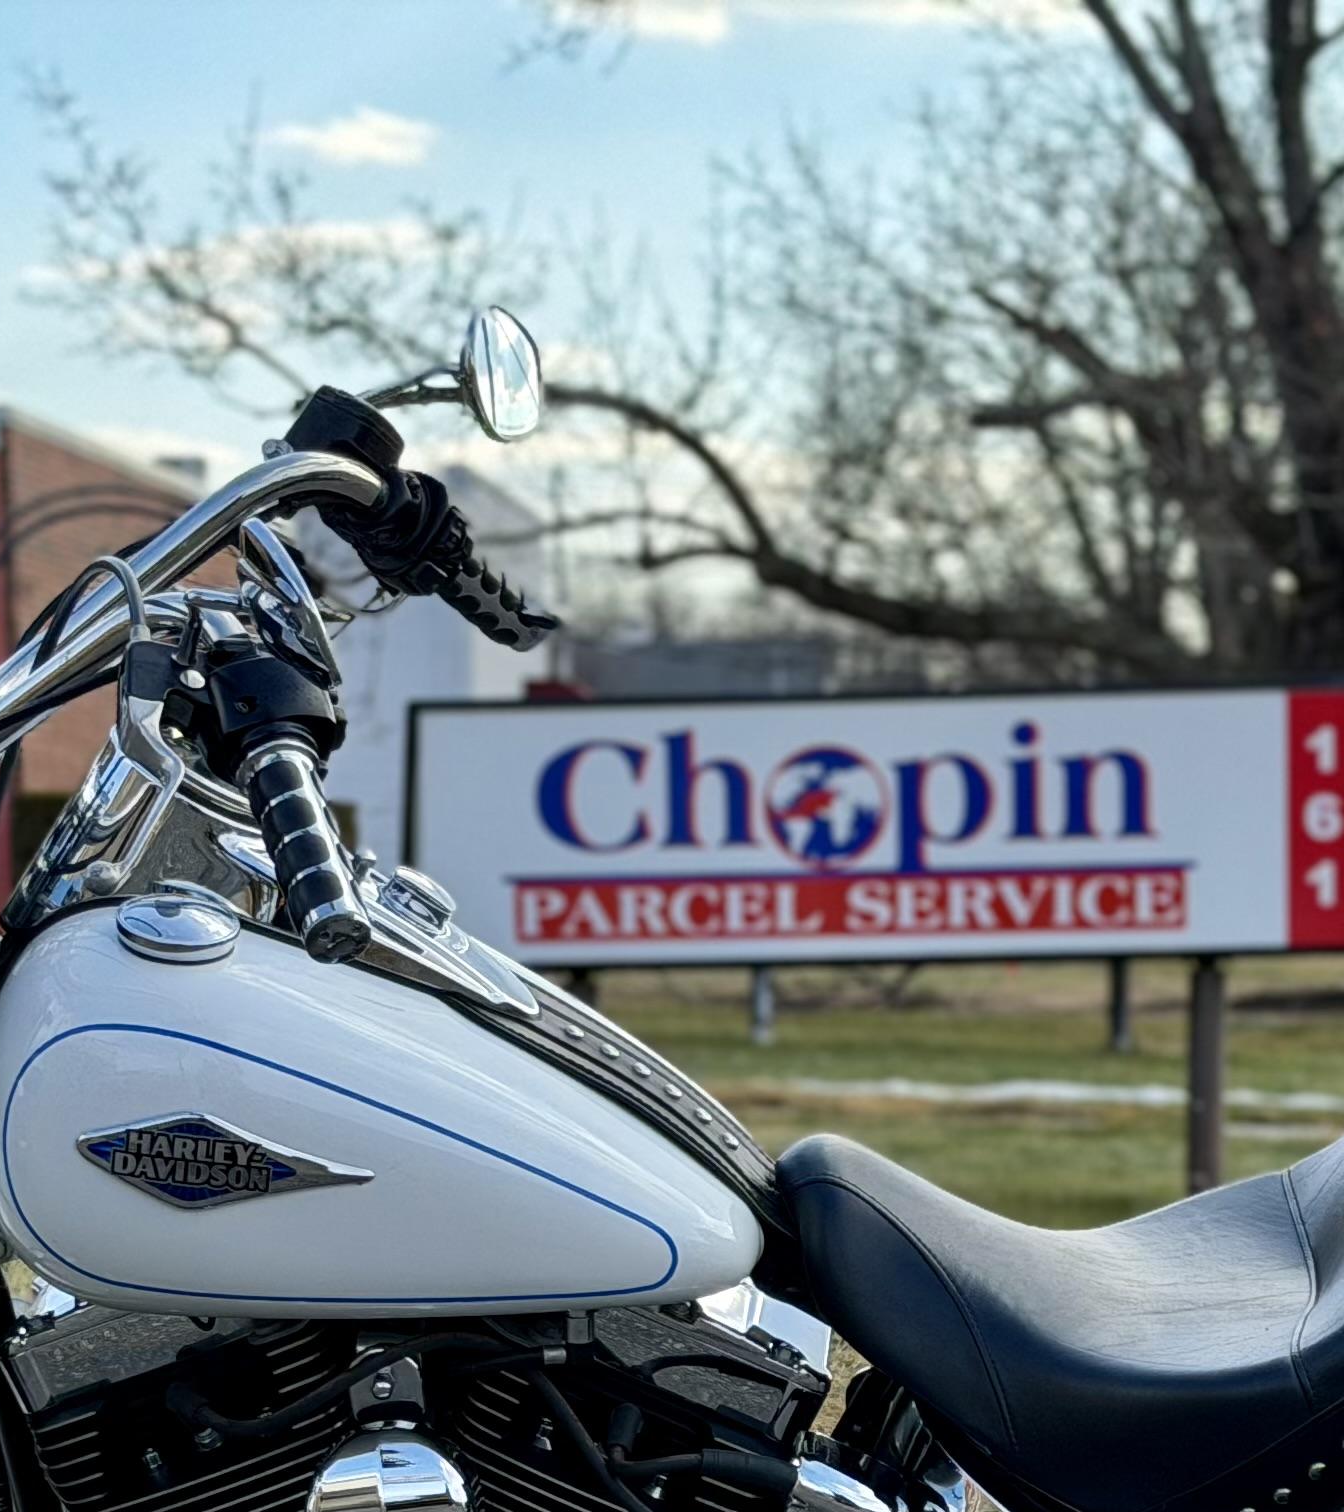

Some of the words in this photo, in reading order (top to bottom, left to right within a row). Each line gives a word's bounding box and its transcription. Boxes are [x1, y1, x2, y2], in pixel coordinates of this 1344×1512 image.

[535, 719, 1160, 872] Chopin
[1303, 723, 1344, 910] 161
[520, 882, 824, 939] PARCEL
[845, 873, 1183, 932] SERVICE
[113, 1152, 270, 1192] DAVIDSON
[128, 1132, 267, 1167] HARLEY-
